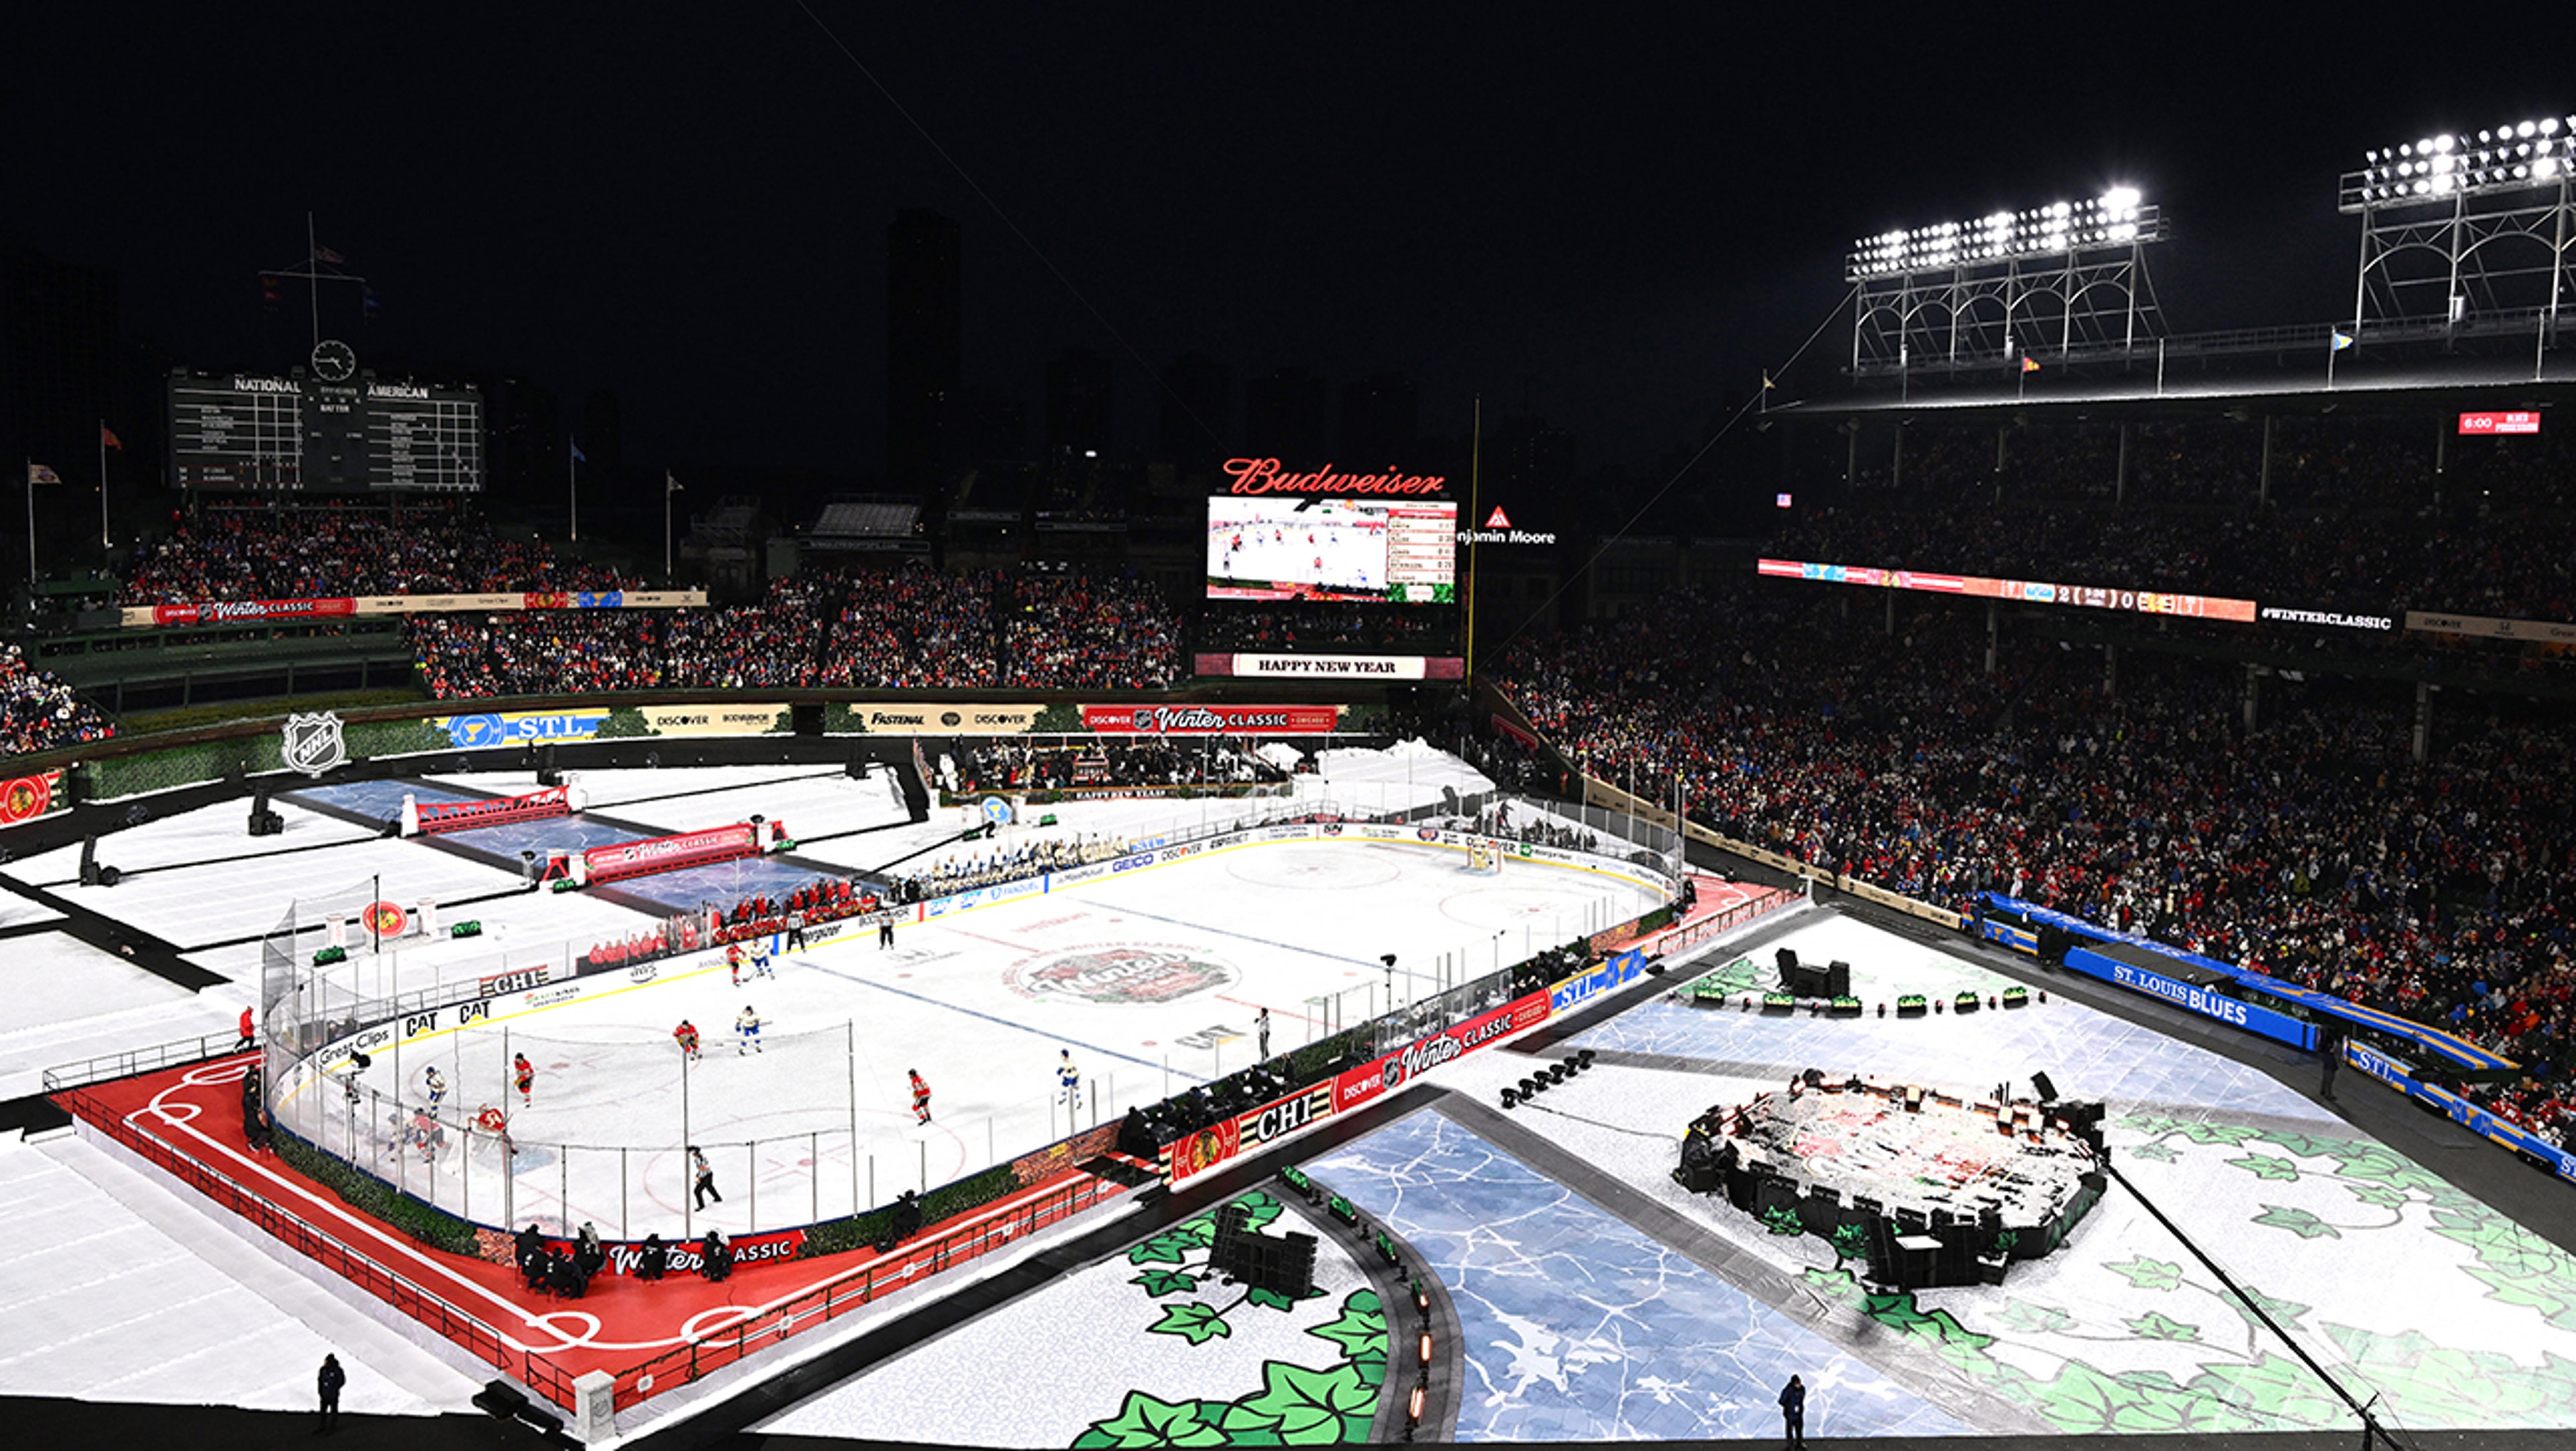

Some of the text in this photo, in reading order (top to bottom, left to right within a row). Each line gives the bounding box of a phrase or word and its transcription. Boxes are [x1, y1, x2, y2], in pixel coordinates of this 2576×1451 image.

[235, 379, 301, 392] NATIONAL
[368, 385, 428, 398] AMERICAN
[320, 405, 350, 413] BATTER
[2464, 418, 2492, 429] 6:00
[1223, 458, 1445, 494] Budweiser
[1509, 530, 1556, 544] Moore
[2059, 586, 2070, 602] 2
[2121, 592, 2133, 608] 0
[213, 602, 268, 620] Winter
[269, 602, 313, 612] CLASSIC
[2261, 607, 2392, 630] #WINTERCLASSIC
[1258, 660, 1396, 673] HAPPY NEW YEAR
[518, 716, 582, 739] STL
[657, 715, 709, 727] DISCOVER
[974, 714, 1026, 725] DISCOVER
[1089, 716, 1132, 724] DISCOVER
[1154, 706, 1226, 733] Winter
[1228, 713, 1288, 727] CLASSIC
[299, 730, 332, 762] NHL
[1112, 853, 1154, 872] GEICO
[1162, 843, 1201, 861] DISCOVER
[494, 970, 539, 994] CHI
[1561, 974, 1596, 1007] STL
[2114, 965, 2247, 1026] ST. LOUIS BLUES
[460, 1000, 491, 1024] CAT
[407, 1012, 437, 1037] CAT
[320, 1029, 389, 1065] Great Clips
[1401, 1031, 1462, 1081] Winter
[1464, 1014, 1513, 1048] CLASSIC
[2358, 1051, 2394, 1083] STL
[1344, 1075, 1381, 1099] DISCOVER
[1257, 1094, 1313, 1142] CHI
[609, 1245, 704, 1275] Wter
